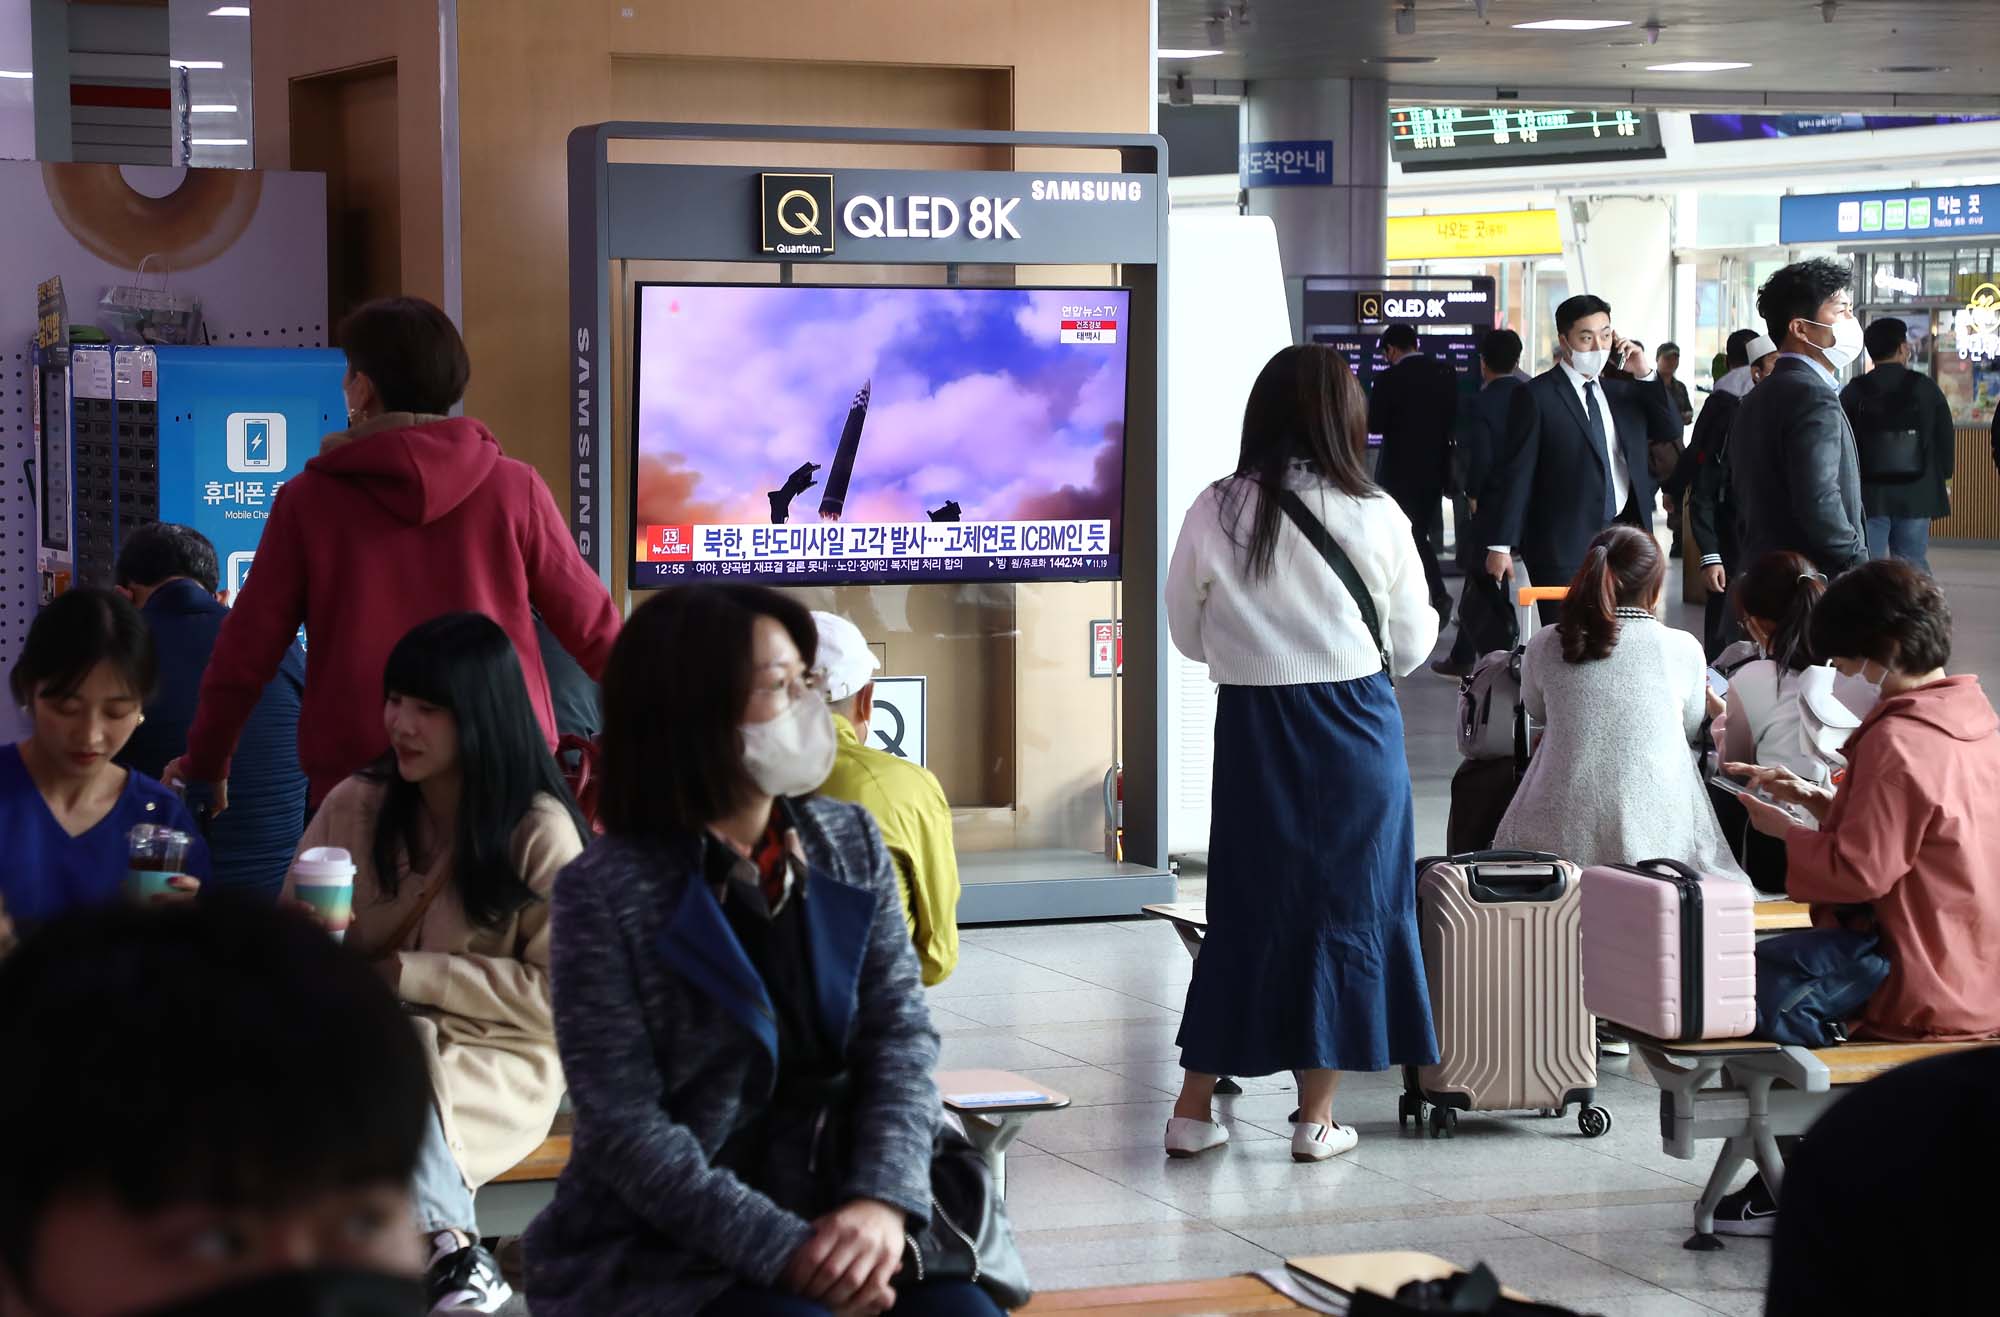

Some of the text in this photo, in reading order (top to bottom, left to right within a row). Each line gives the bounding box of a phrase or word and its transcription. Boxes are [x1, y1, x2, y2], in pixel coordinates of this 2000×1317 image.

[1031, 179, 1142, 202] SAMSUNG
[777, 189, 822, 236] Q
[843, 195, 1022, 240] QLED 8K
[776, 243, 821, 255] Quantum
[1062, 305, 1118, 318] 연합뉴스TV
[1363, 298, 1379, 316] Q
[1384, 298, 1446, 318] QLED 8K
[1076, 331, 1101, 341] 태백시
[577, 327, 591, 557] SAMSUNG
[203, 481, 266, 505] 휴대폰
[225, 510, 271, 519] Mobile Cha
[664, 530, 678, 543] 13
[703, 528, 747, 560] 북한,
[752, 527, 844, 557] 탄도미사일
[849, 526, 887, 556] 고각
[1021, 524, 1083, 552] ICBM인
[1087, 524, 1106, 552] 듯
[652, 544, 690, 555] 뉴스센터
[655, 563, 685, 575] 12:55
[696, 561, 718, 575] 여야,
[721, 561, 751, 575] 양곡법
[753, 560, 783, 574] 재표결
[786, 560, 806, 573] 결론
[890, 559, 920, 571] 복지법
[922, 558, 942, 571] 처리
[944, 558, 963, 571] 합의
[1011, 558, 1046, 569] 원/유로화
[1050, 557, 1083, 568] 1442.94
